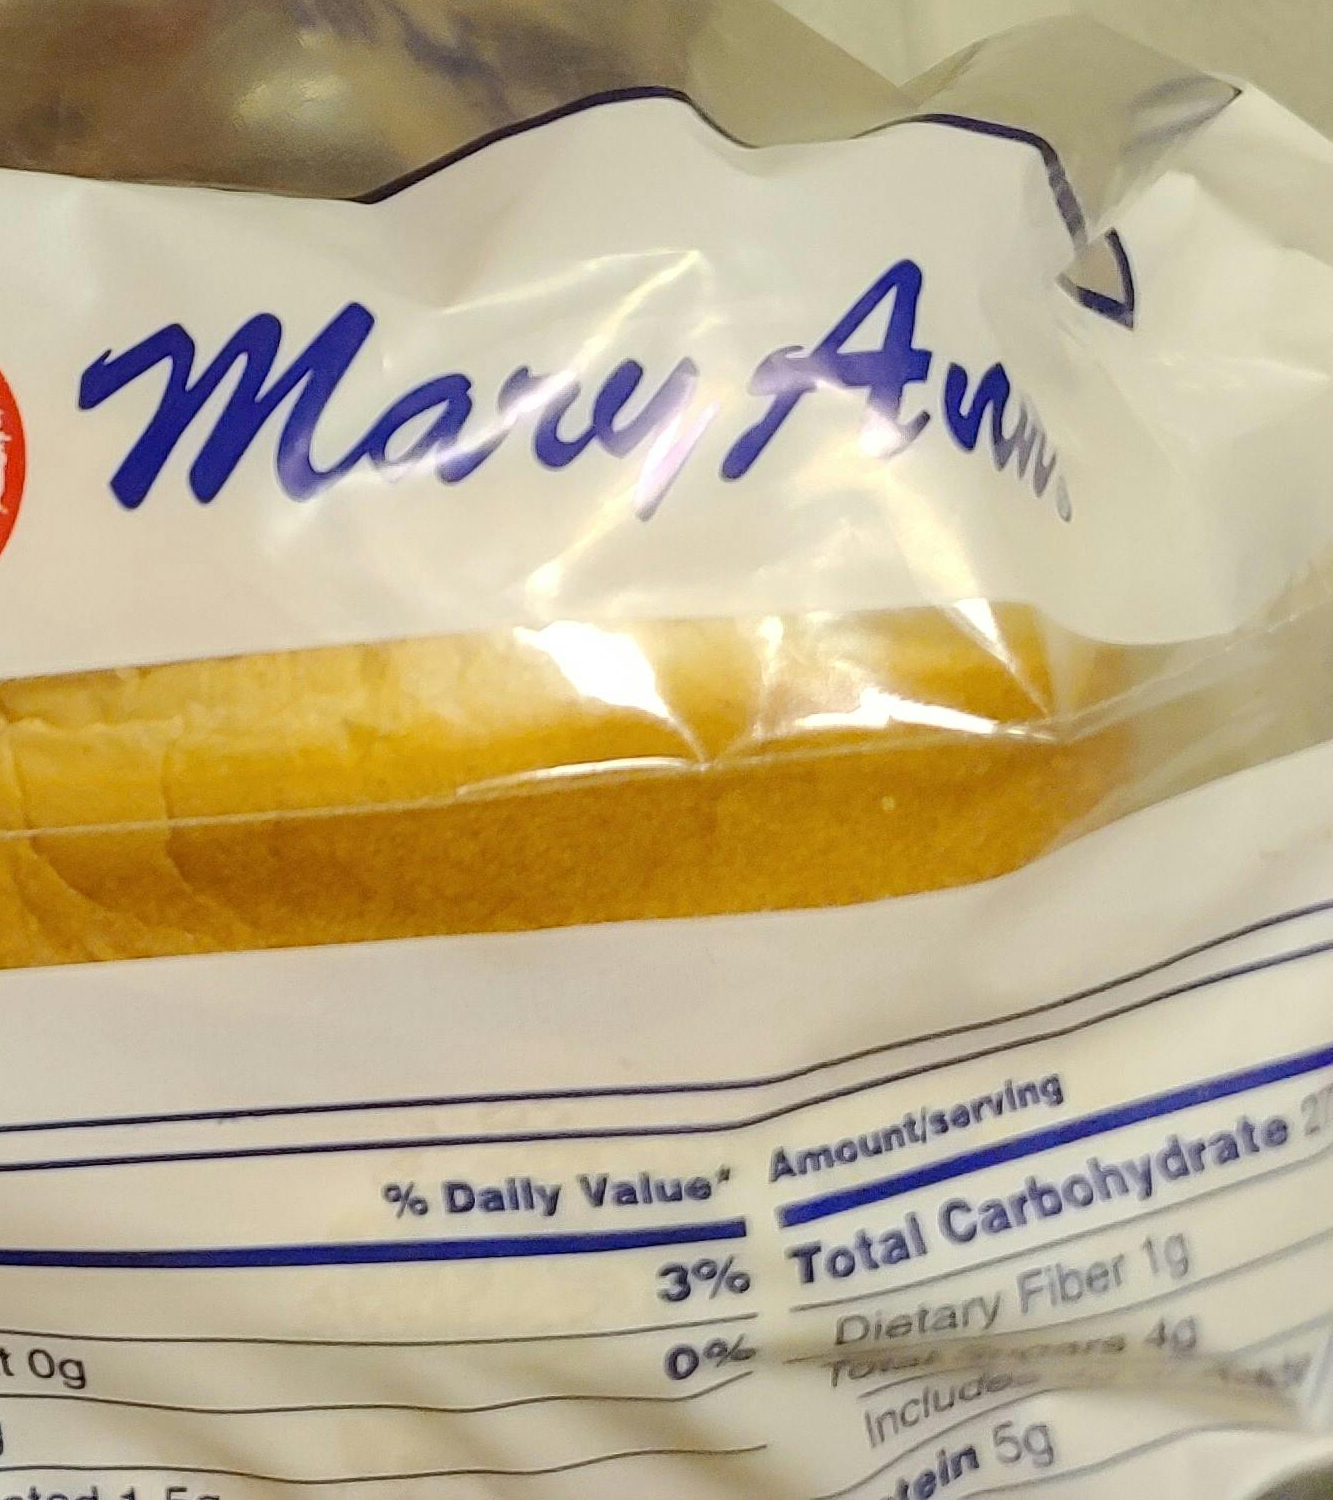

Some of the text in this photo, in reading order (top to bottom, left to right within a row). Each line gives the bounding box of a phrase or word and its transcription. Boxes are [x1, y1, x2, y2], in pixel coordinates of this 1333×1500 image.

[78, 301, 717, 522] Mary
[768, 1072, 1064, 1183] Amount/serving
[382, 1181, 429, 1219] %
[442, 1176, 562, 1217] Daily
[785, 1211, 928, 1285] Total
[938, 1113, 1291, 1246] Carbohydrate
[656, 1255, 752, 1302] 3%
[834, 1232, 1191, 1346] Dietary Fiber 1g
[27, 1348, 87, 1390] 0g
[664, 1333, 757, 1381] 0%
[992, 1420, 1055, 1469] 5g
